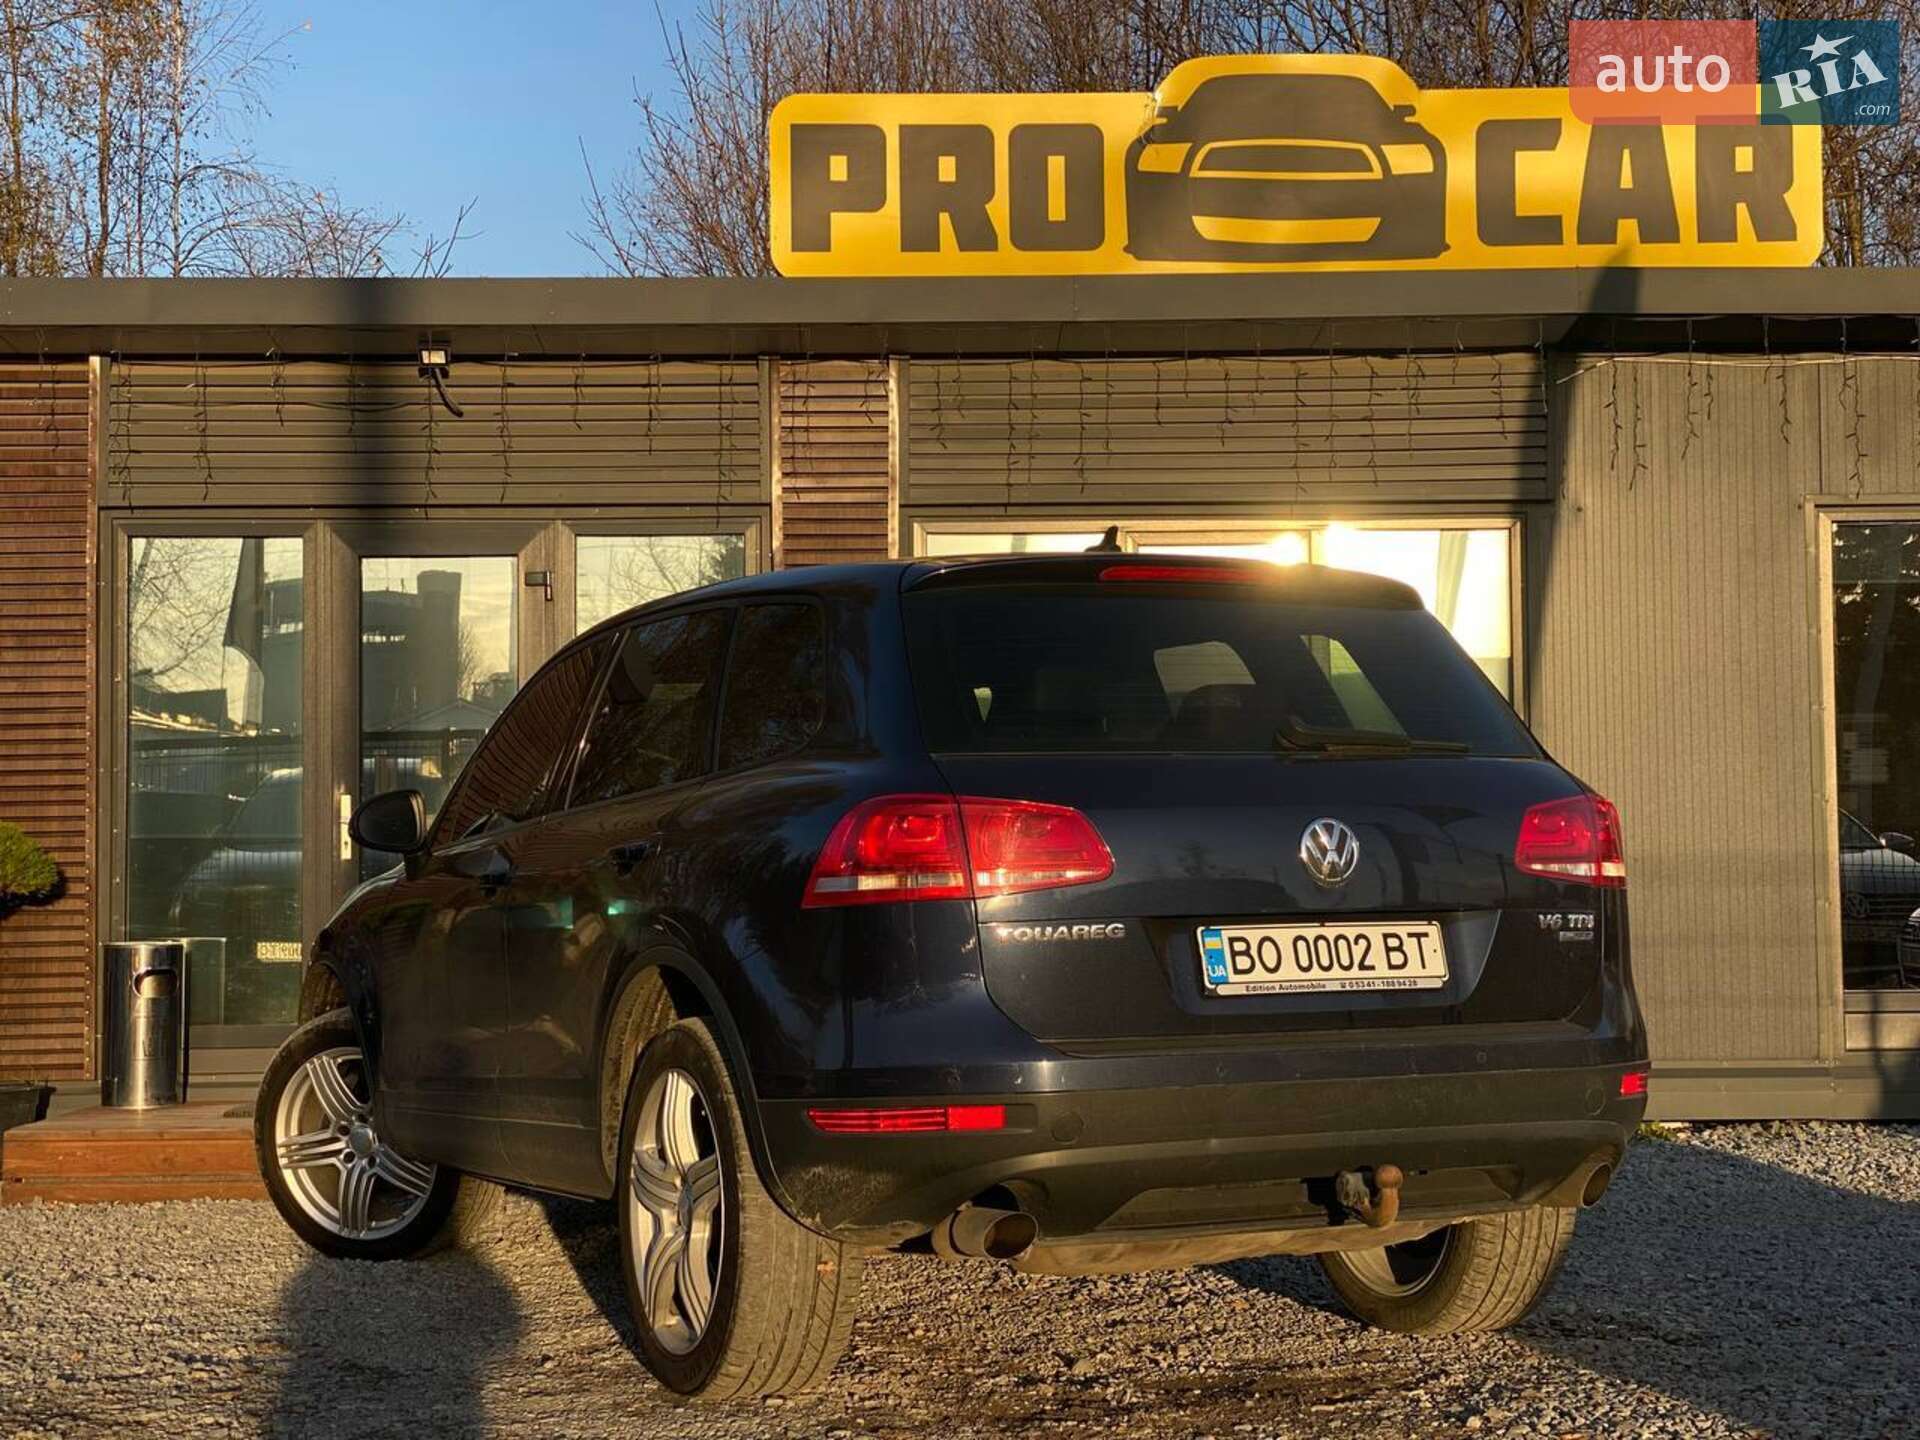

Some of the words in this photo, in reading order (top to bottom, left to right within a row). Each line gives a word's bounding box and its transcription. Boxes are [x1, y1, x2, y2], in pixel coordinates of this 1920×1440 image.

[790, 123, 1106, 252] PRO
[1475, 115, 1798, 246] CAR
[1539, 913, 1561, 929] V6
[1567, 913, 1595, 928] TDI
[996, 922, 1126, 942] TOUAREG
[1227, 935, 1283, 976] BO
[1293, 933, 1376, 973] 0002
[1381, 931, 1429, 971] BT
[1208, 965, 1226, 977] UA
[1245, 983, 1277, 993] Edition
[1278, 981, 1327, 992] Automobile
